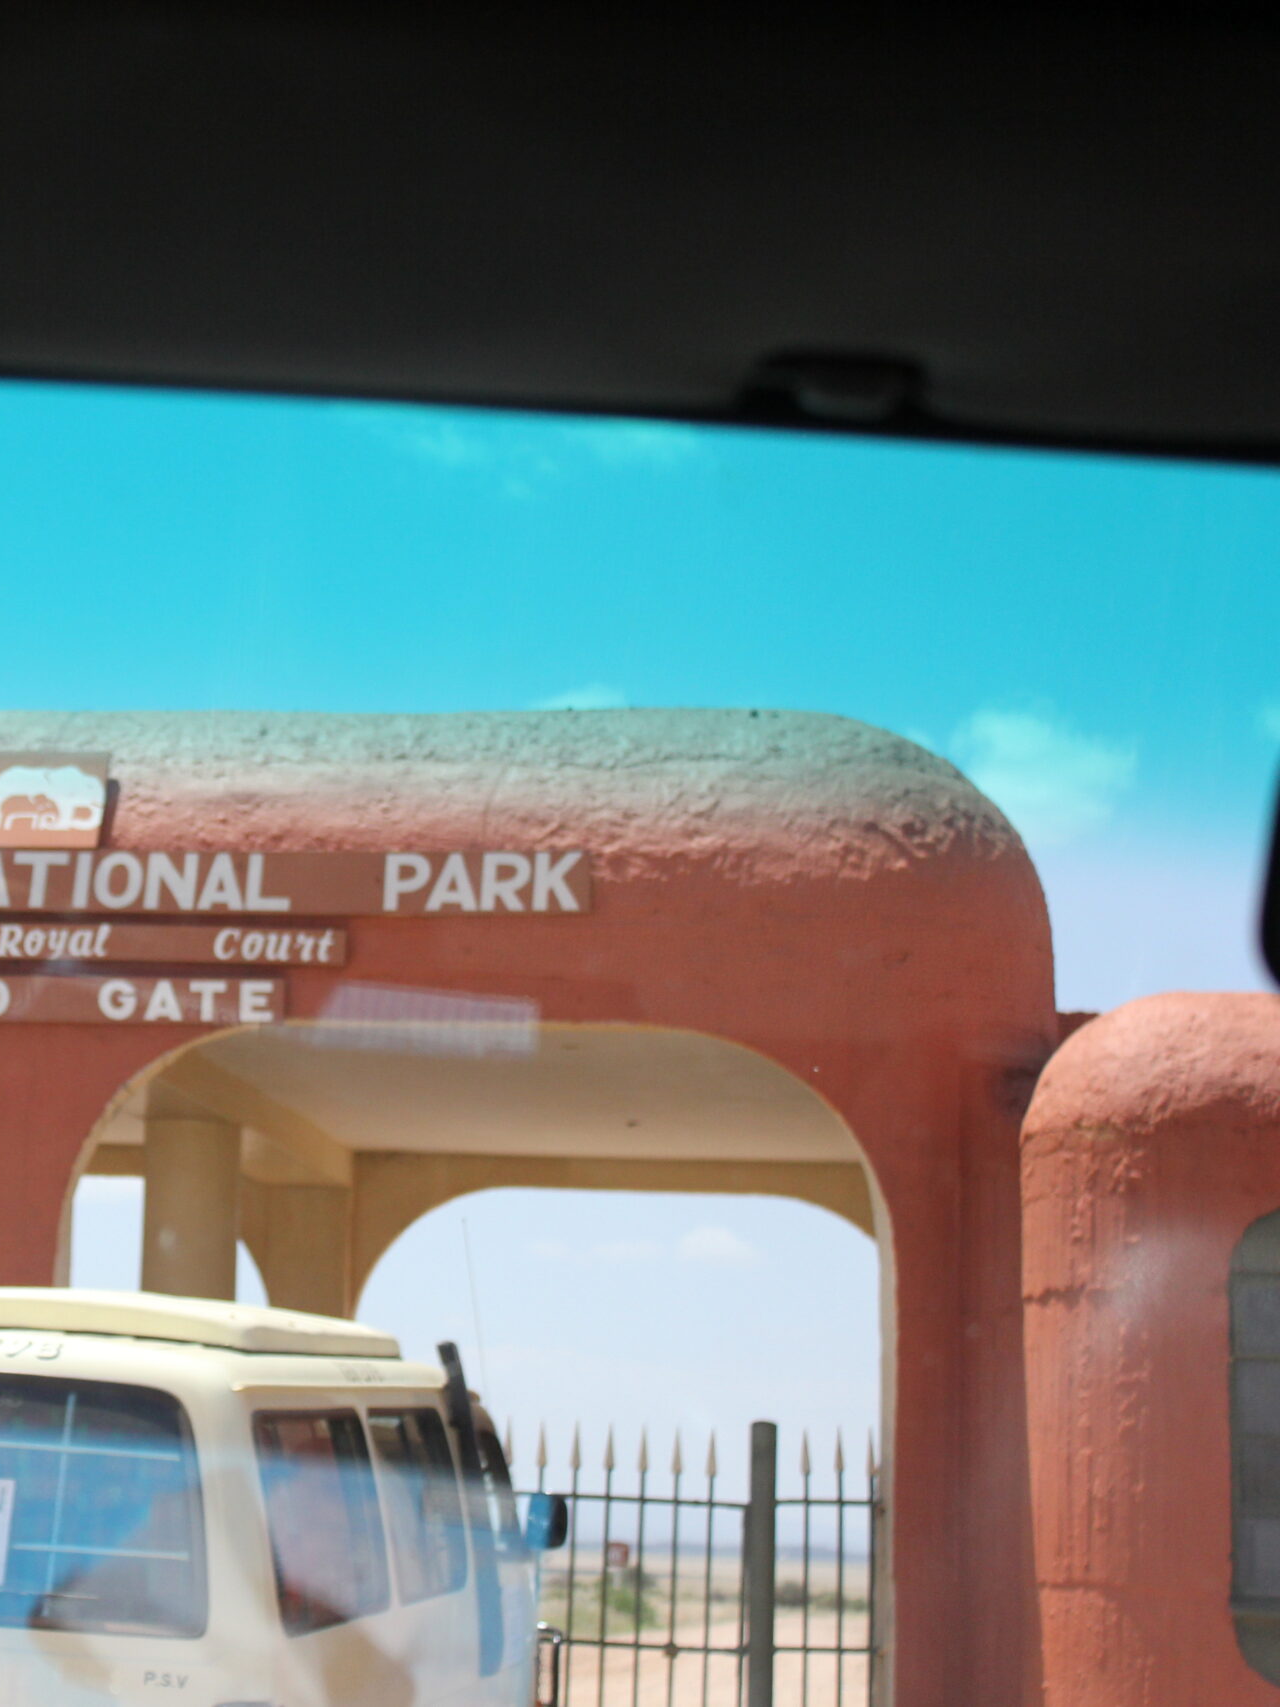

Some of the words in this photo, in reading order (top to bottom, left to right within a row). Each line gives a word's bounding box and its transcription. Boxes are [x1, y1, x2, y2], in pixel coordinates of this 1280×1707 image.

[382, 850, 583, 911] PARK
[213, 928, 334, 963] Court
[97, 979, 274, 1022] GATE
